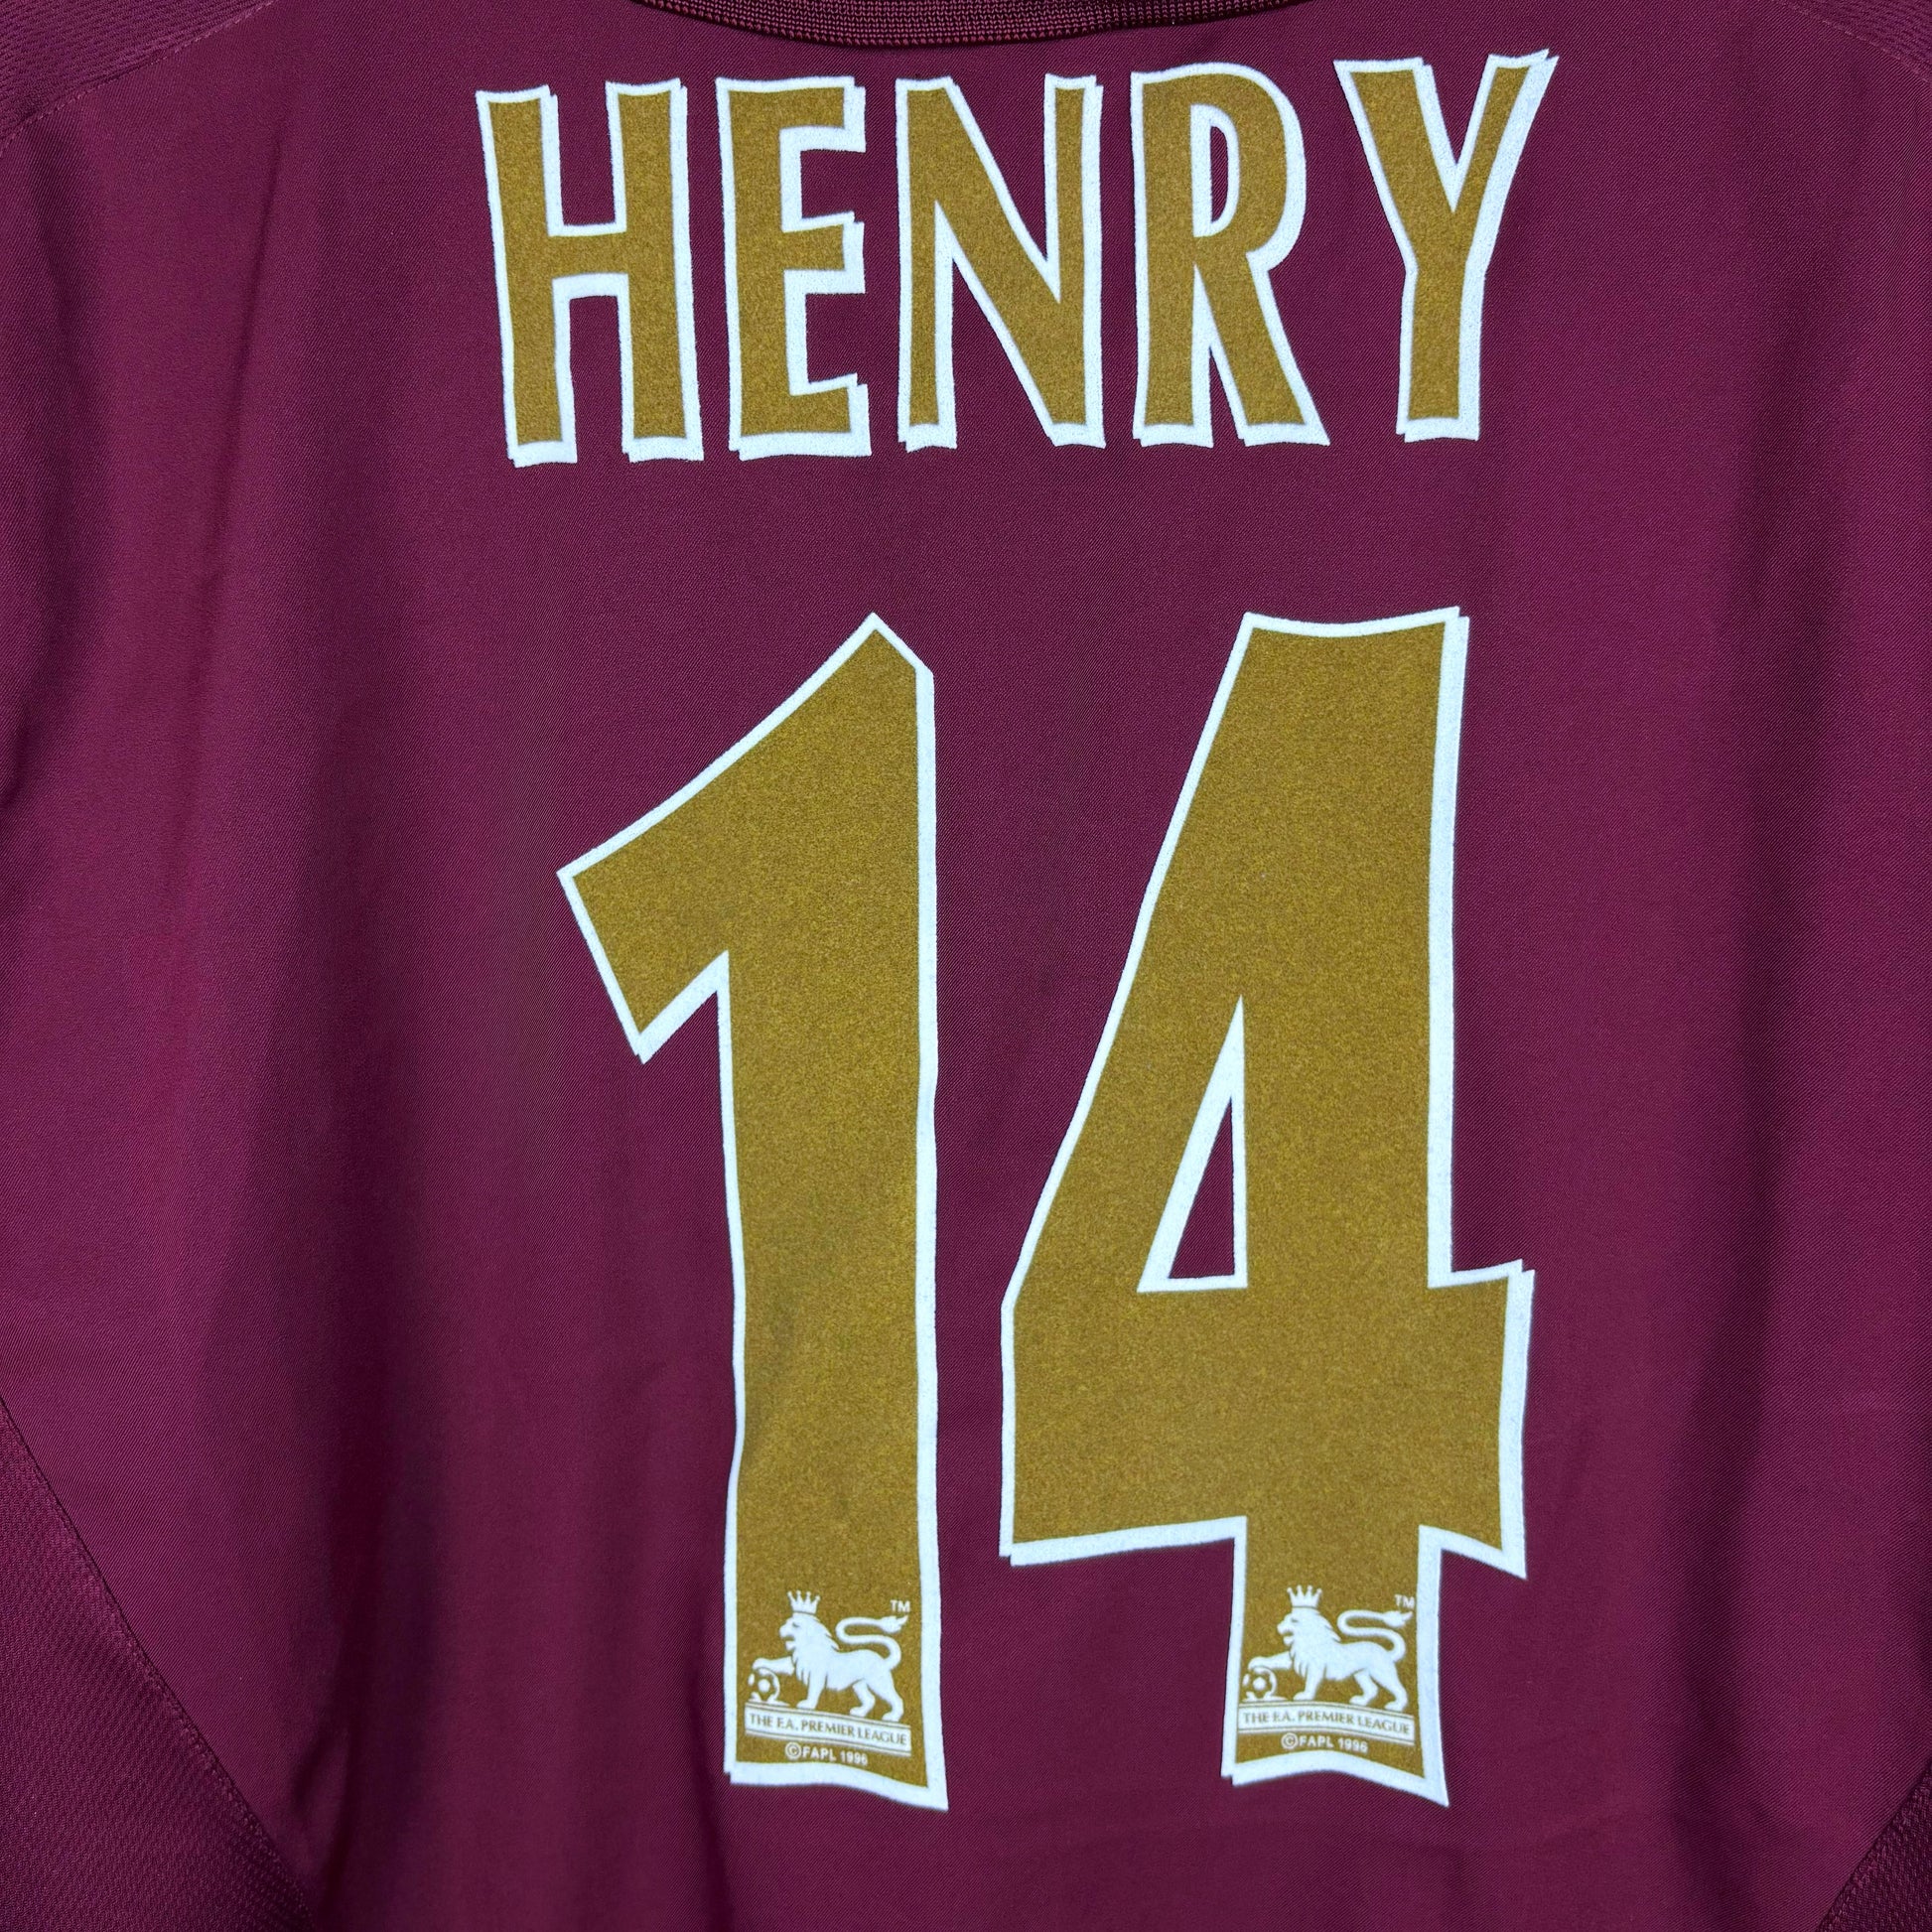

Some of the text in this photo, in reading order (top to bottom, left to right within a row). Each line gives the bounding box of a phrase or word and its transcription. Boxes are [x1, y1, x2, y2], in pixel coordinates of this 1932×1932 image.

[477, 50, 1558, 467] HENRY
[558, 607, 1534, 1810] 14
[891, 1599, 911, 1613] TM
[1395, 1593, 1415, 1609] TM
[750, 1714, 772, 1725] THE
[801, 1721, 855, 1735] PREMIER
[858, 1729, 906, 1744] LEAGUE
[1244, 1713, 1269, 1724] THE
[1298, 1711, 1355, 1725] PREMIER
[1358, 1717, 1409, 1734] LEAGUE
